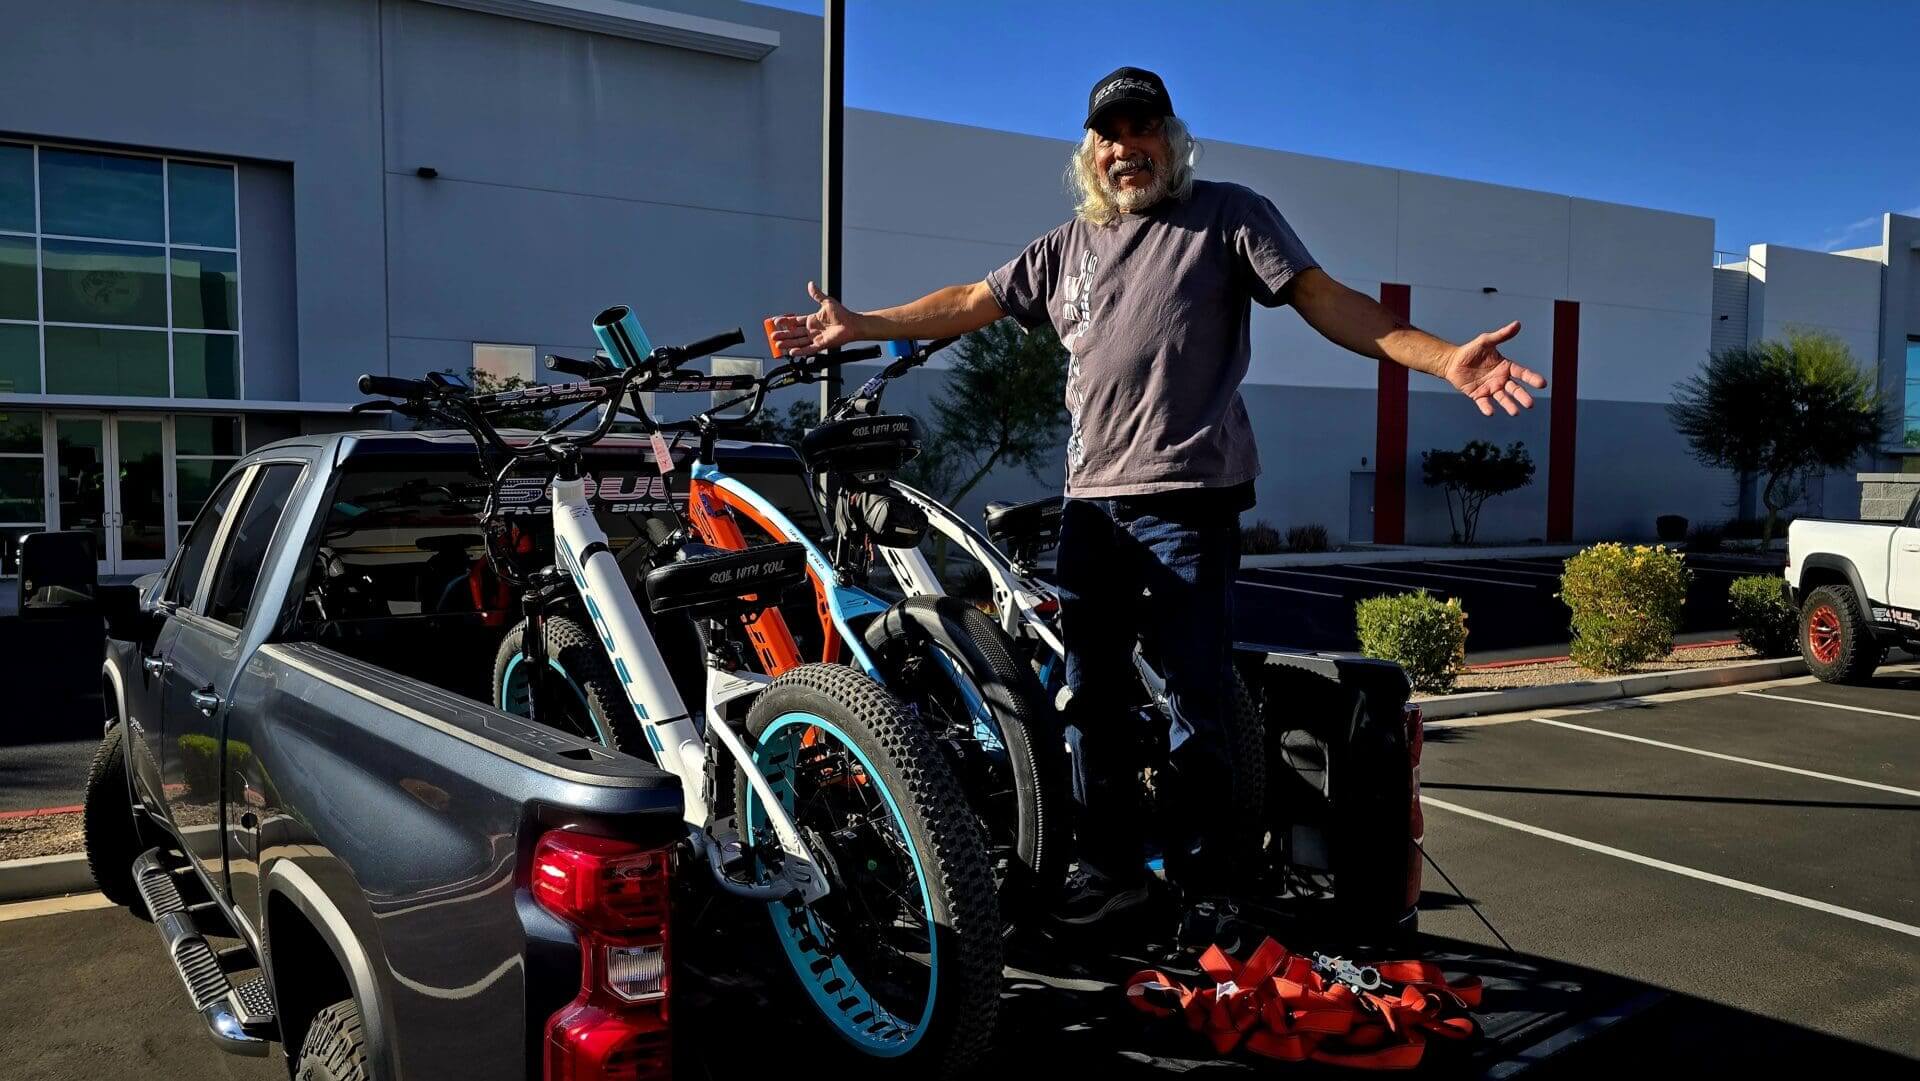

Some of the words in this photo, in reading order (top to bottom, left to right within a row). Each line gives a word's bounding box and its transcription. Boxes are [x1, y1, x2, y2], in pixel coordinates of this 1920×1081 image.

[496, 380, 607, 401] SOUL
[497, 505, 552, 516] FAS
[611, 503, 684, 513] BIKES
